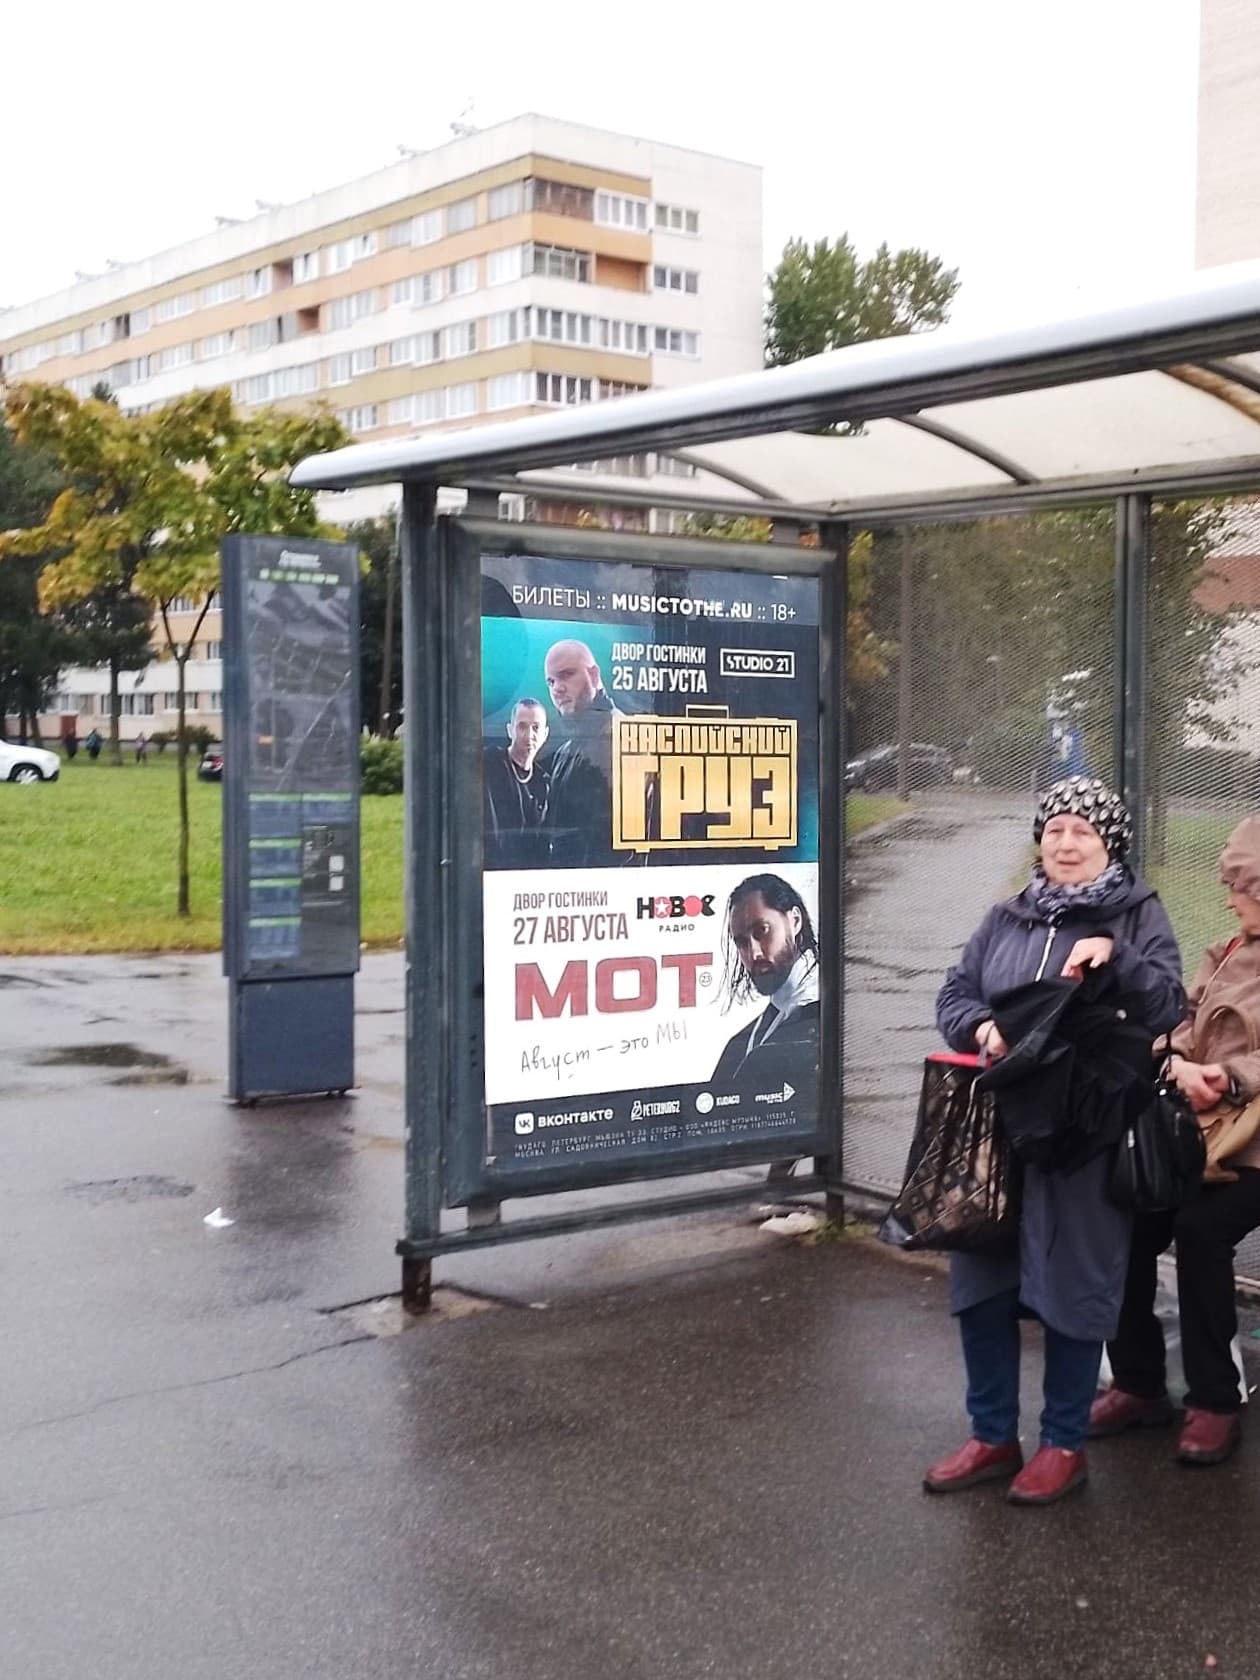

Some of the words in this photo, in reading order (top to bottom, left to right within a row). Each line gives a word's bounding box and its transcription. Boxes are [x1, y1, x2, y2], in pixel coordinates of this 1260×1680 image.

[512, 585, 591, 609] БИЛЕТЫ
[612, 593, 753, 618] MUSICTOTHE.RU
[771, 603, 797, 621] 18+
[611, 642, 644, 662] ДВОР
[646, 644, 706, 664] ГОСТИНКИ
[726, 655, 774, 672] STUDIO
[776, 657, 790, 672] 21
[612, 666, 634, 691] 25
[637, 667, 708, 693] АВГУСТА
[620, 723, 791, 755] КАСПИЙСКИЙ
[621, 755, 791, 841] ГРУЗ
[513, 893, 546, 912] ДВОР
[548, 891, 608, 909] ГОСТИНКИ
[513, 916, 538, 945] 27
[543, 913, 629, 944] АВГУСТА
[658, 923, 696, 933] РАДИО
[514, 952, 714, 1021] МОТ
[521, 1045, 591, 1081] Август
[619, 1036, 649, 1054] это
